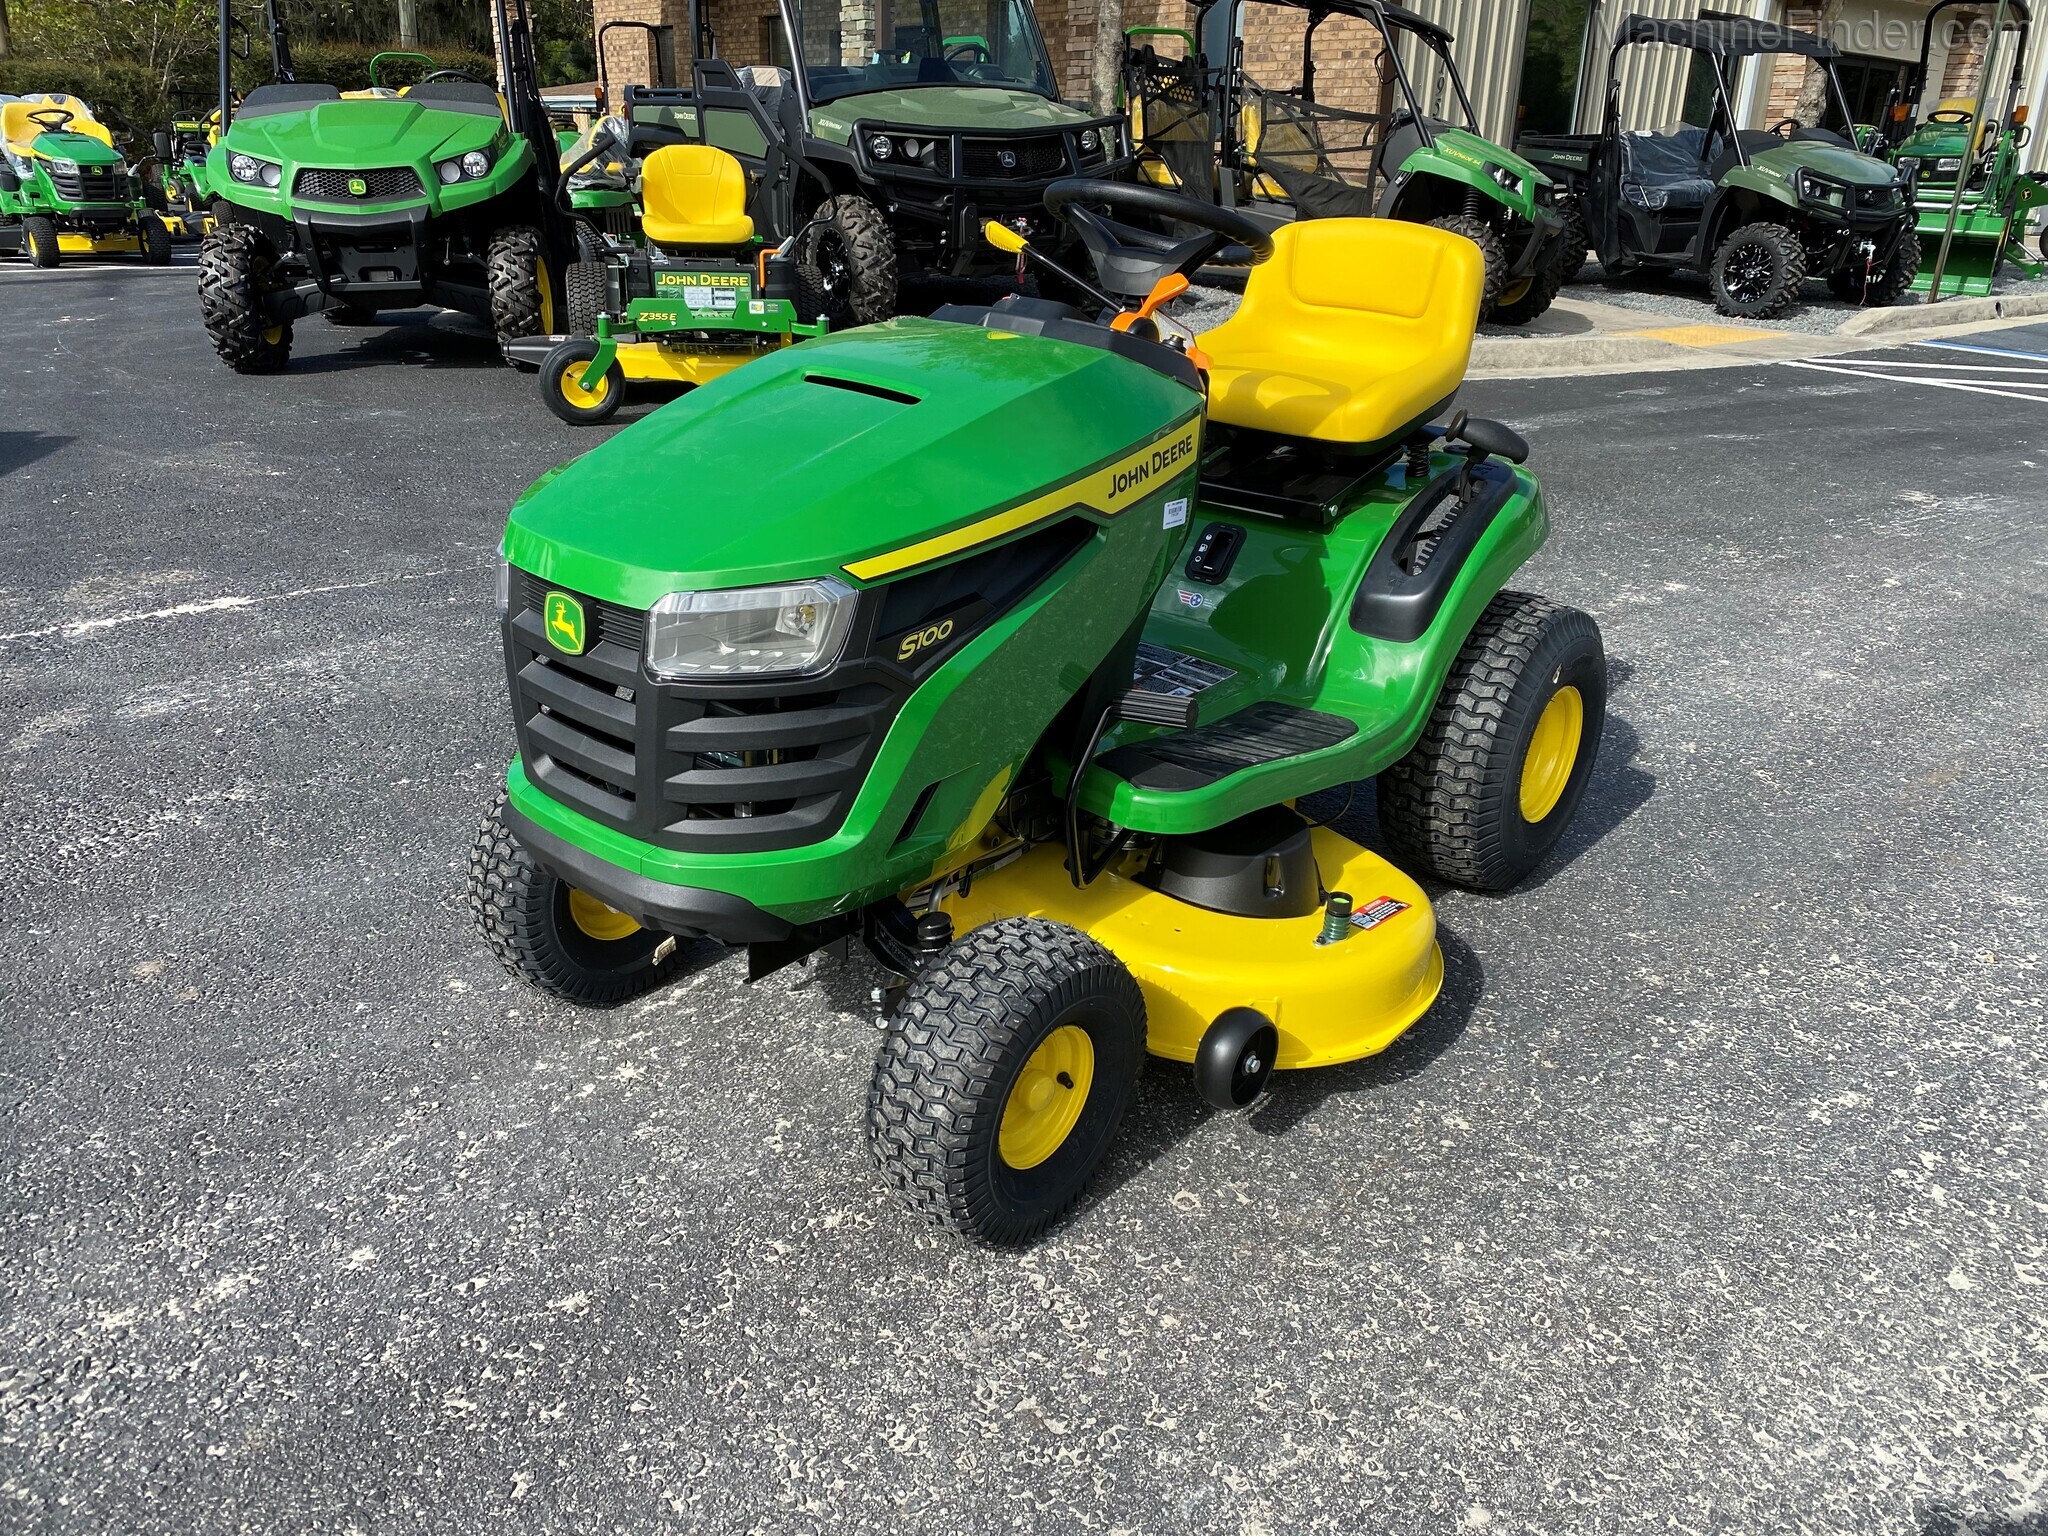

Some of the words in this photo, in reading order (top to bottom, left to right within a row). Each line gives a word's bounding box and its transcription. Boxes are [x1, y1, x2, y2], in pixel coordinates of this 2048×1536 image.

[657, 273, 697, 286] JOHN
[700, 274, 749, 286] DEERE
[1107, 460, 1149, 499] JOHN
[1152, 433, 1193, 475] DEERE
[898, 619, 954, 661] S100
